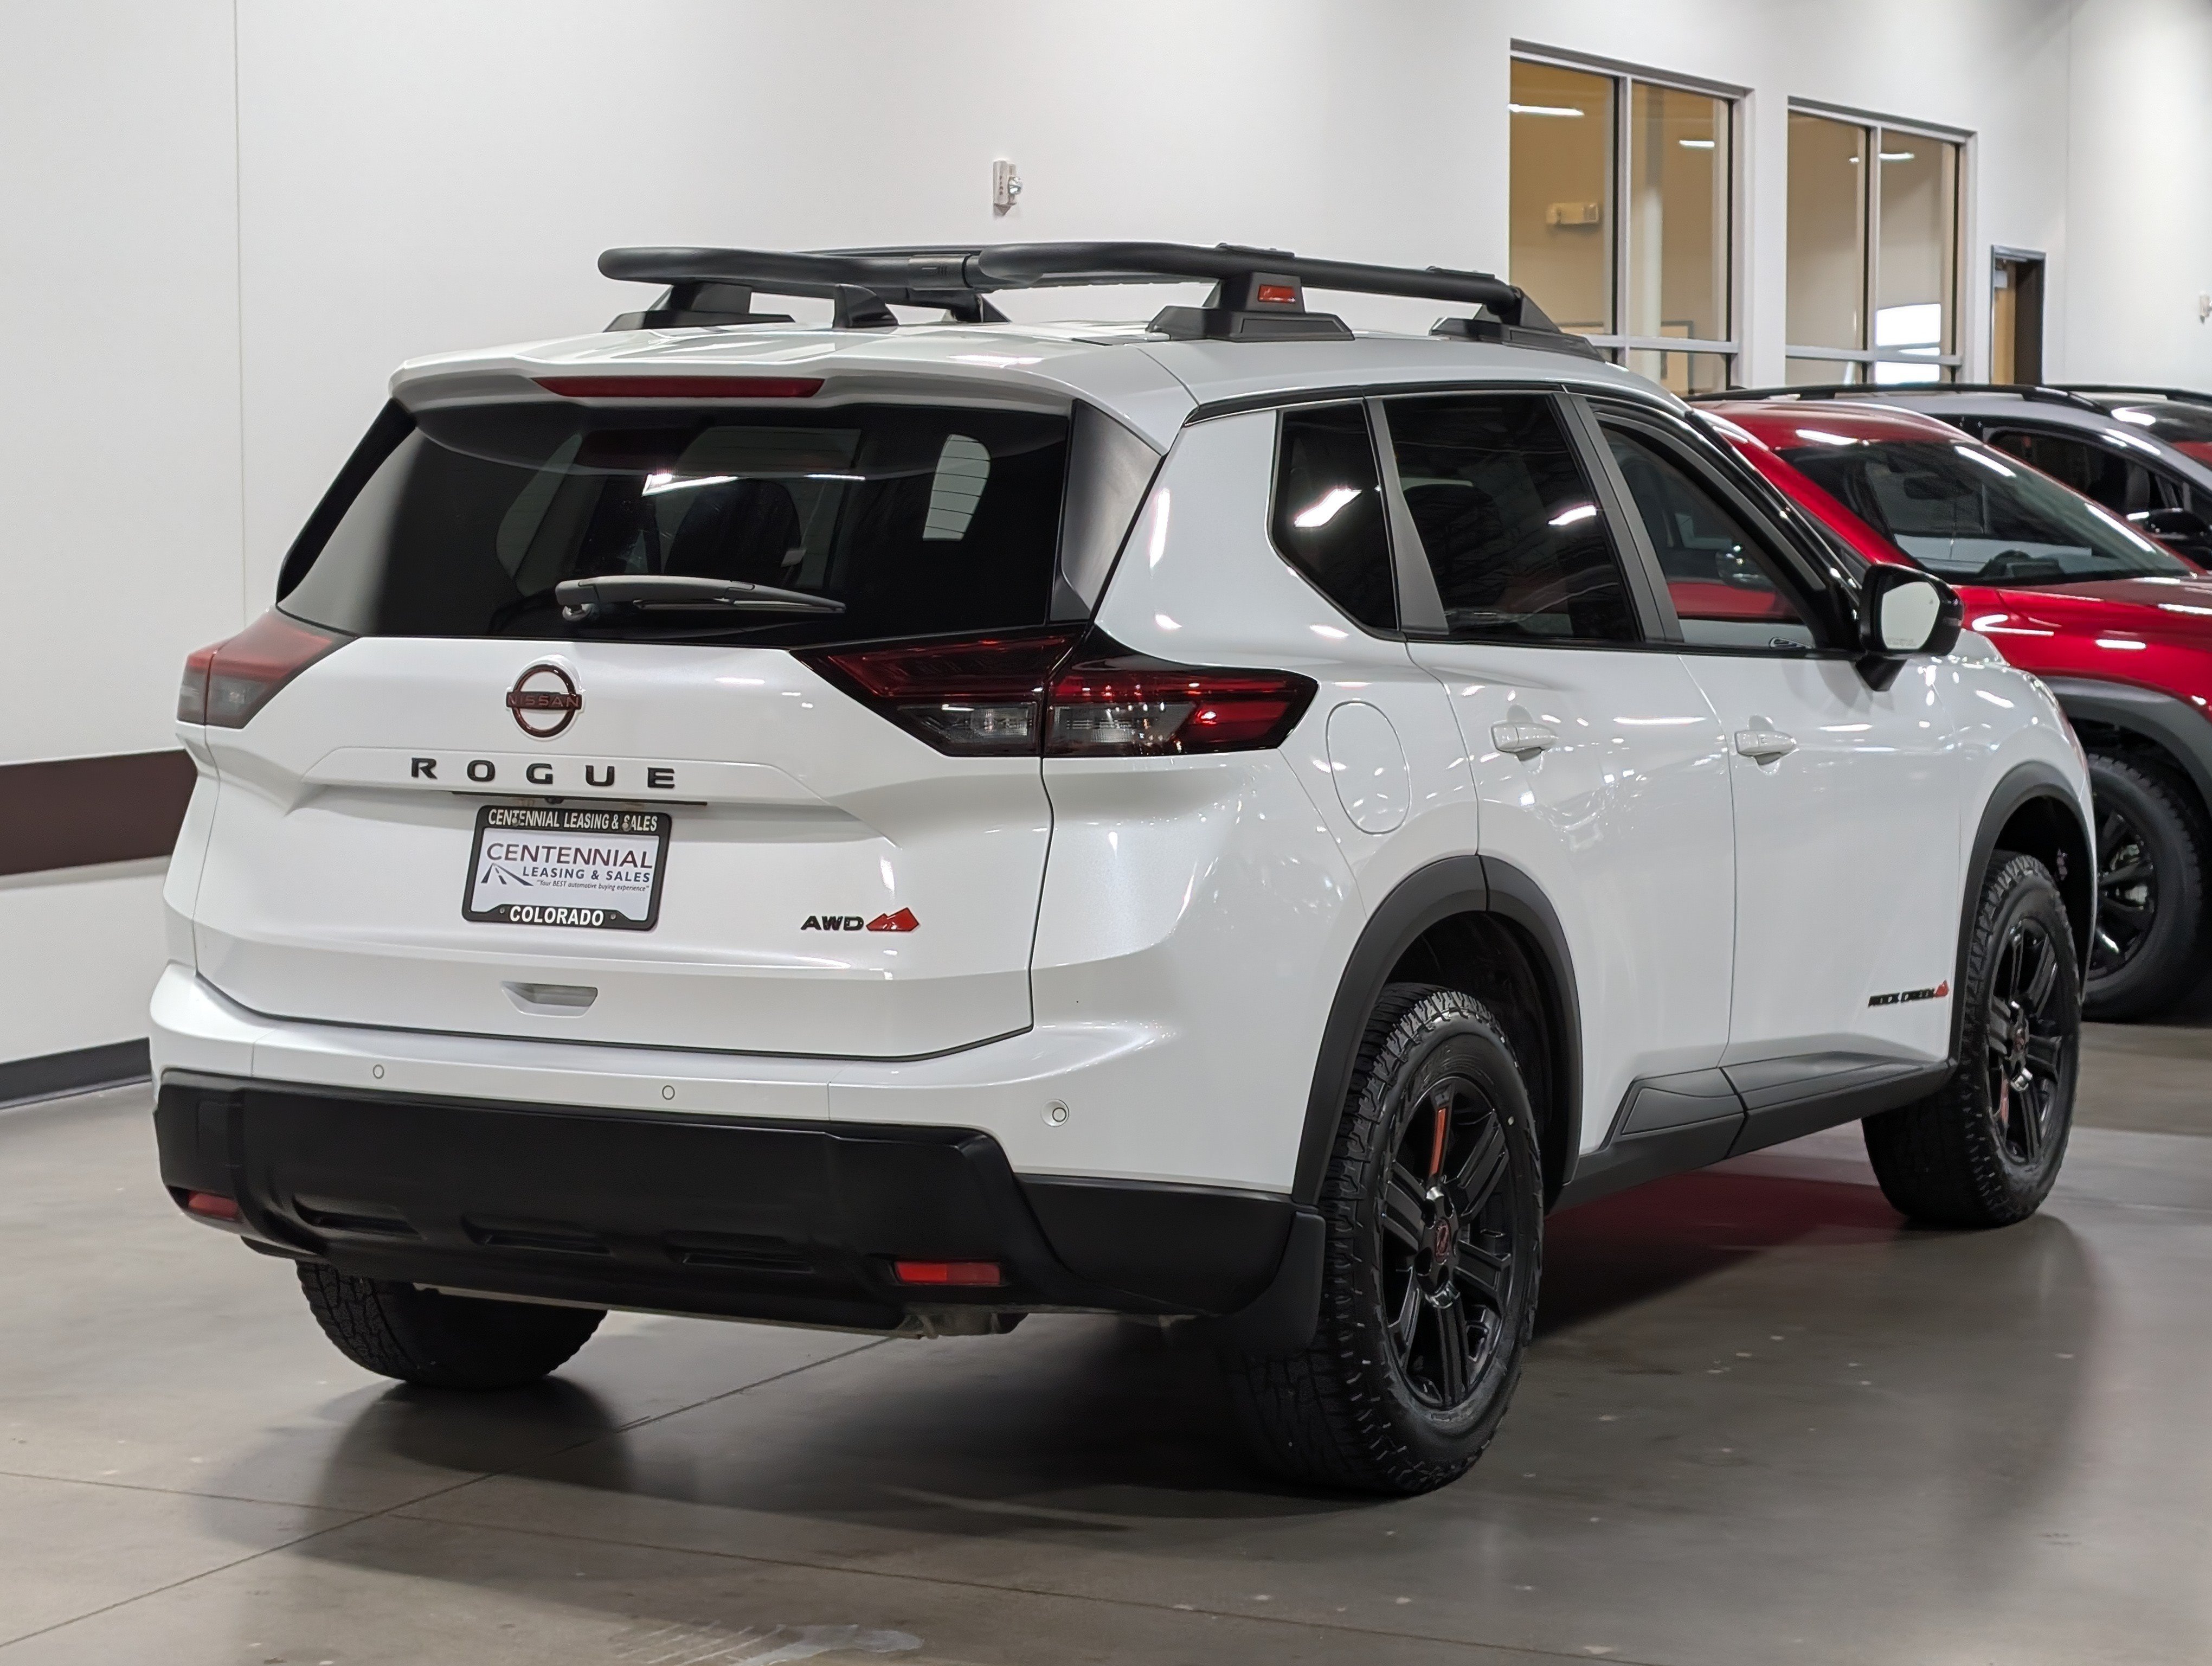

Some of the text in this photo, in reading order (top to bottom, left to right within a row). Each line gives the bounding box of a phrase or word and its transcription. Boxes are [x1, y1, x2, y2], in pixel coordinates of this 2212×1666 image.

[508, 695, 580, 707] NISSAN
[411, 757, 675, 789] ROGUE
[488, 809, 658, 831] CENTENNIAL LEASING & SALES
[487, 843, 653, 869] CENTENNIAL
[523, 866, 650, 883] LEASING & SALES
[599, 883, 615, 892] buying
[510, 906, 604, 926] COLORADO
[800, 915, 864, 931] AWD
